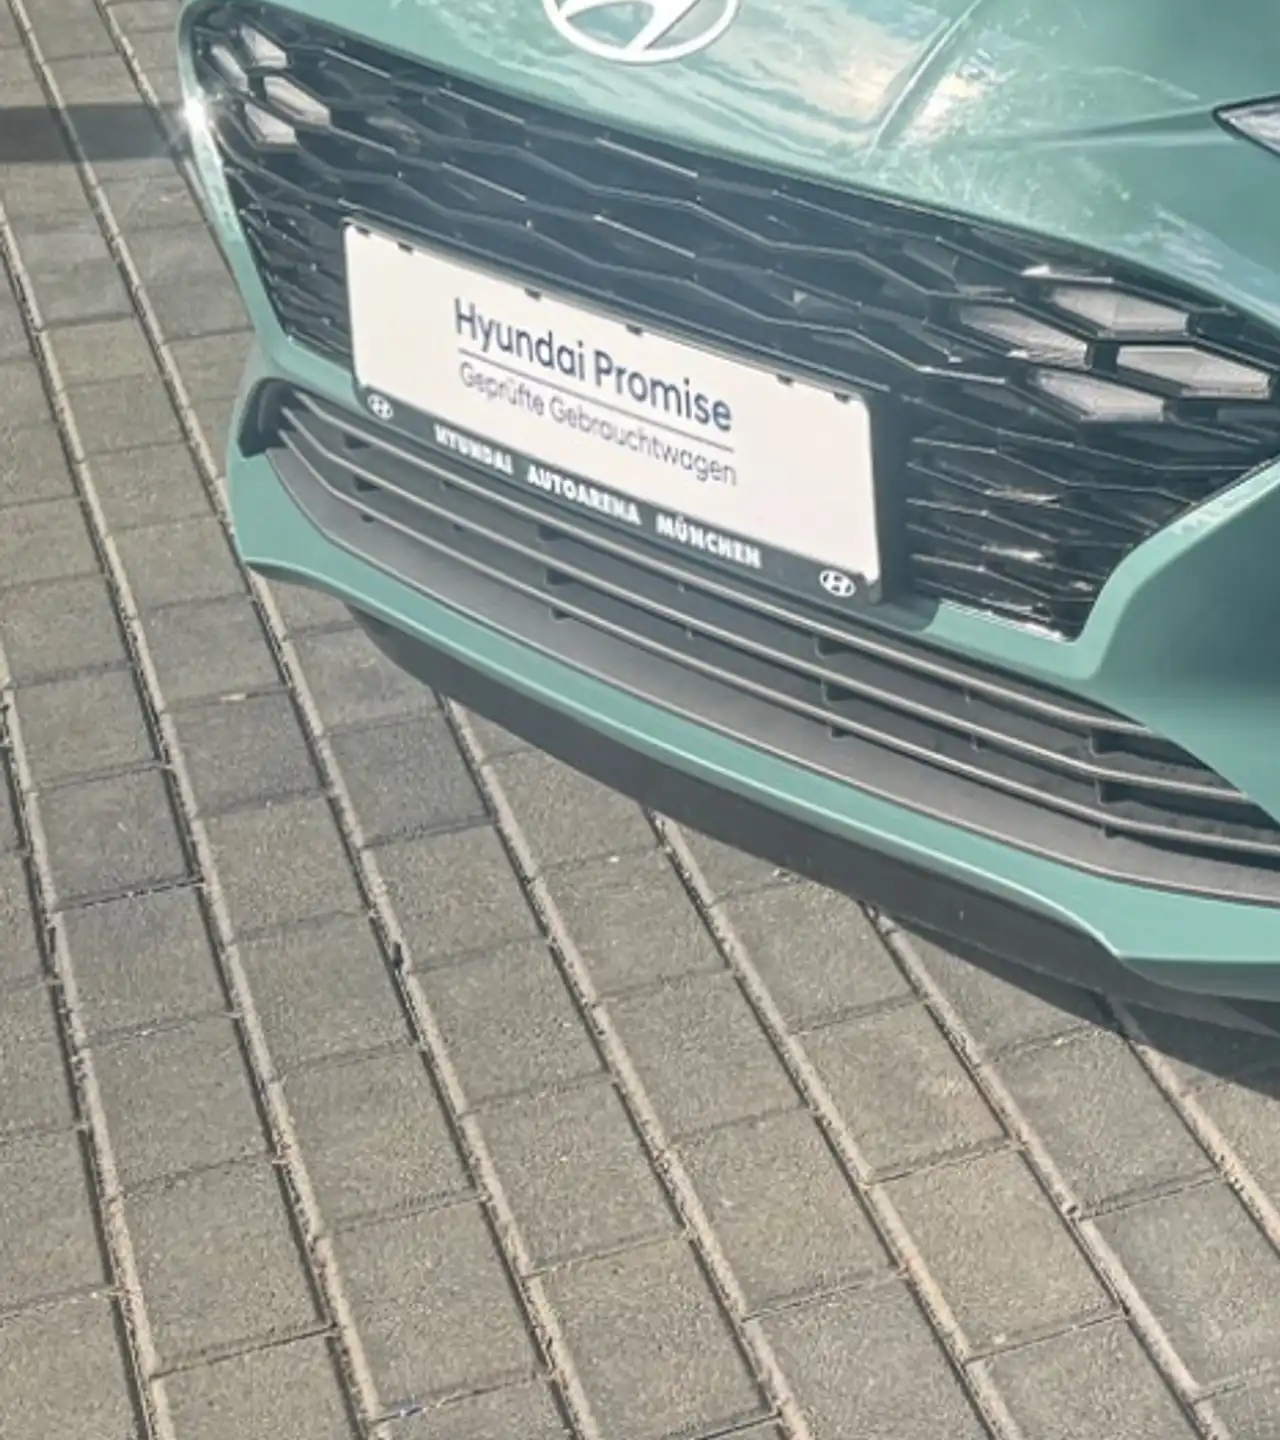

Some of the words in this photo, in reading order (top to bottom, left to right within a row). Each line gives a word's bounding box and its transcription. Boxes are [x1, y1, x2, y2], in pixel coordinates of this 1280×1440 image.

[454, 297, 586, 382] Hyundai
[594, 349, 733, 433] Promise
[458, 360, 545, 418] Geprüfte
[548, 397, 738, 487] Gebrauchtwagen
[432, 423, 515, 477] HYUNDAI
[525, 463, 643, 528] AUTOARENA
[654, 512, 763, 571] MÜNCHEN
